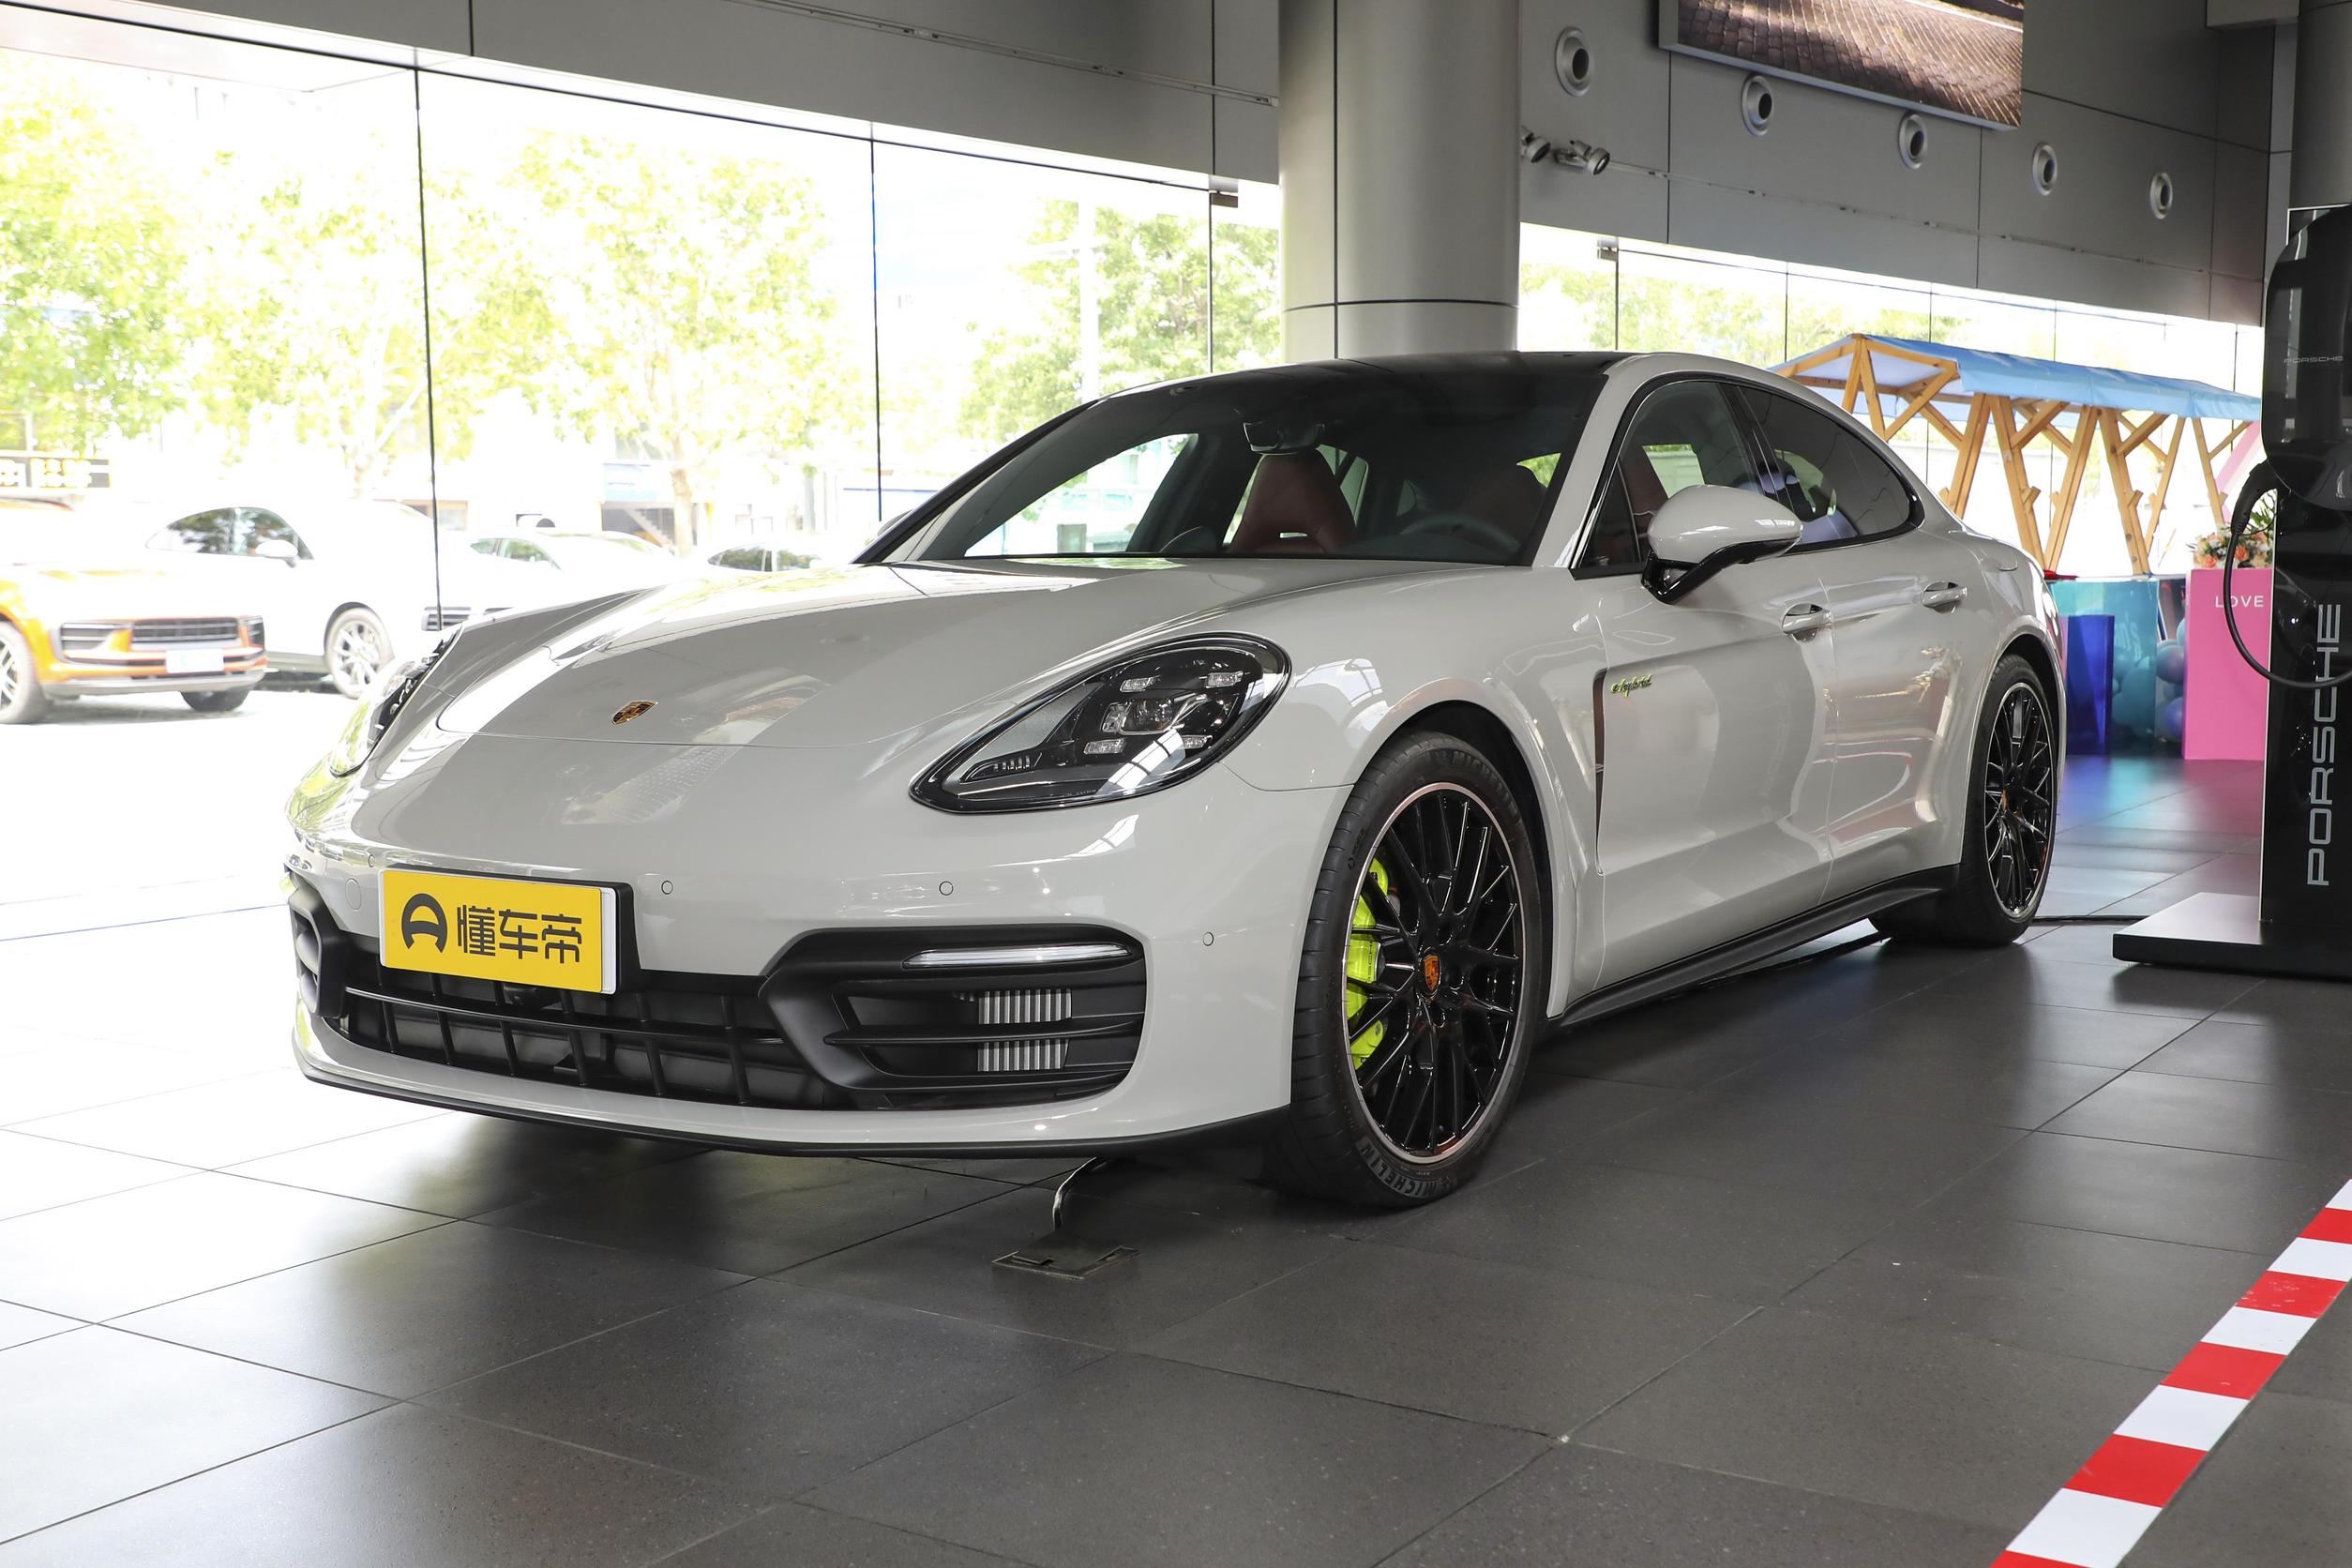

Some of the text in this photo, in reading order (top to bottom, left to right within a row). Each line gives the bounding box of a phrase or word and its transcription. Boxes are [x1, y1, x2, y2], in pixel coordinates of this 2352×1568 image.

[2307, 604, 2342, 886] PORSCHE
[457, 904, 582, 964] 懂车帝
